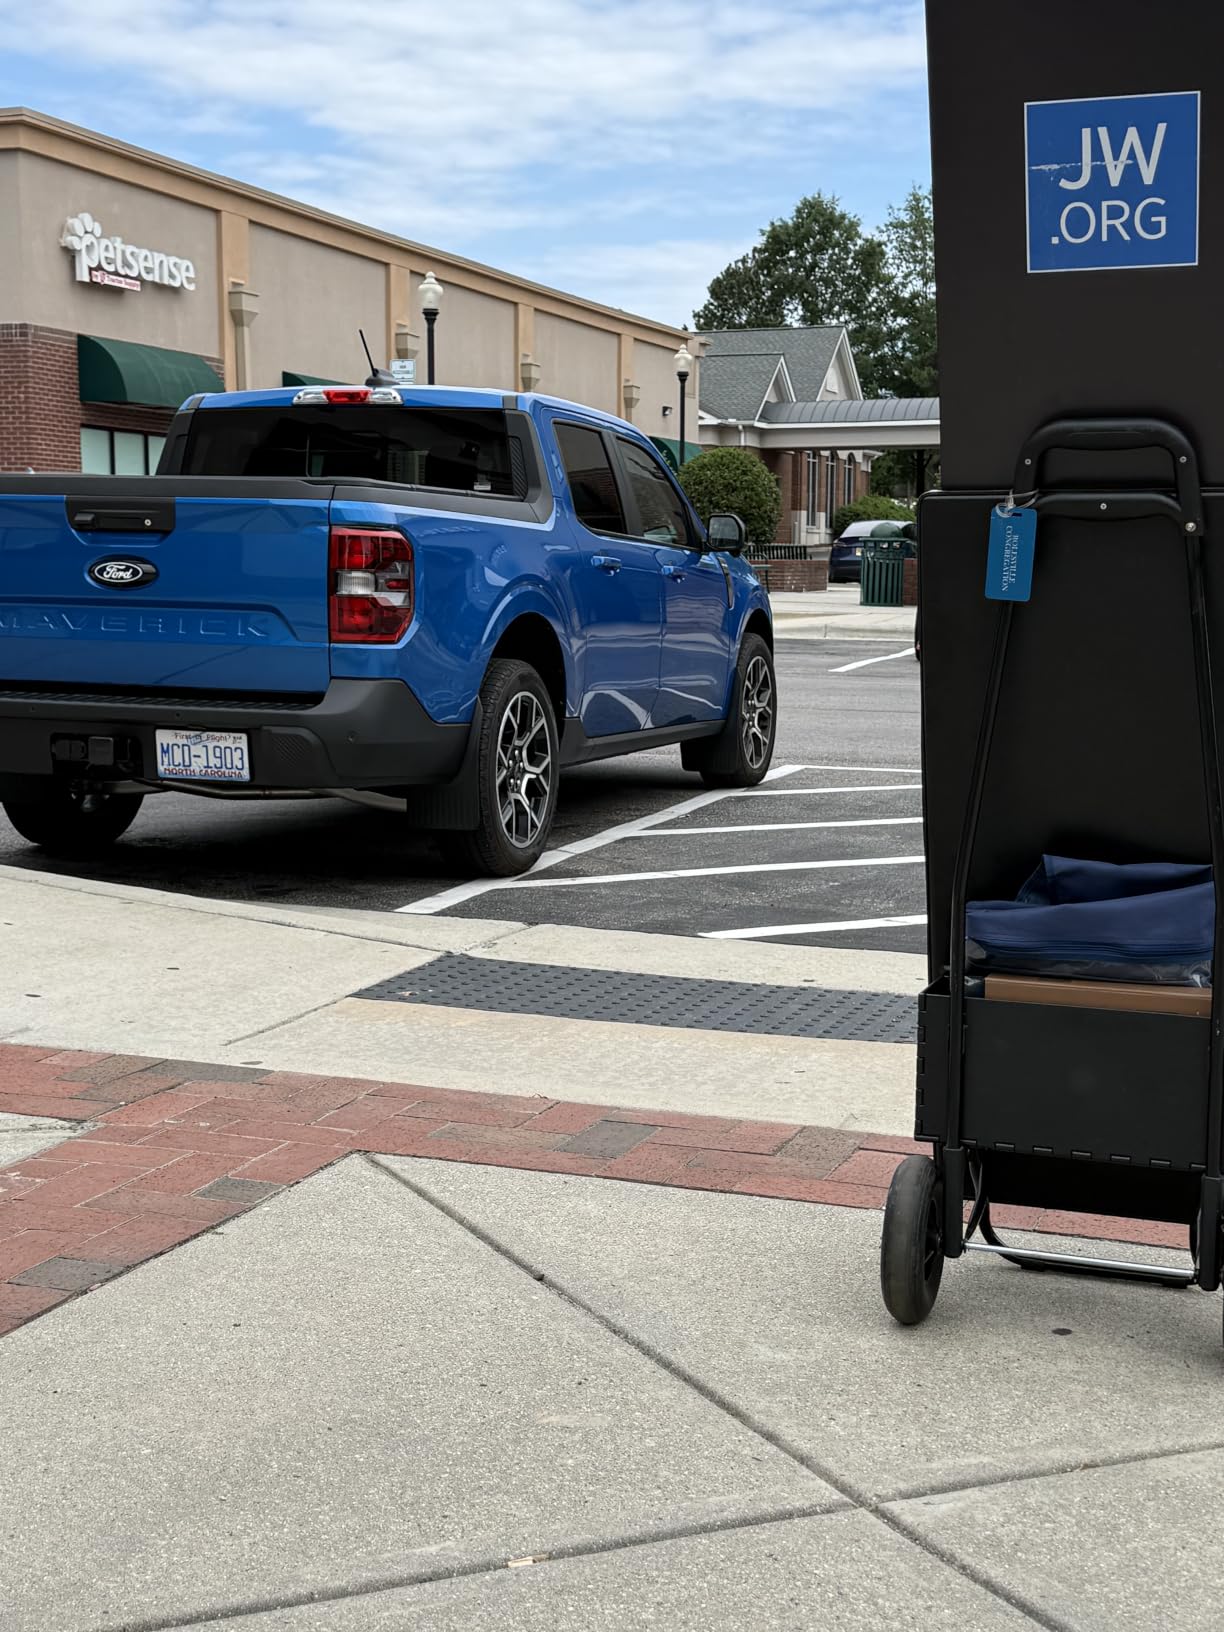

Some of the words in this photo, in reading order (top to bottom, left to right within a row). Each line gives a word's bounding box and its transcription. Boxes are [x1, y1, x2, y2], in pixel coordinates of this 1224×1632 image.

[1058, 122, 1168, 191] JW
[1050, 197, 1168, 245] .ORG
[75, 233, 196, 291] petsense
[103, 564, 134, 579] Ford
[1001, 525, 1013, 592] CONGREGATION
[160, 742, 245, 771] MCD-1903
[164, 767, 196, 777] NORTH
[199, 769, 243, 779] CAROLINA
